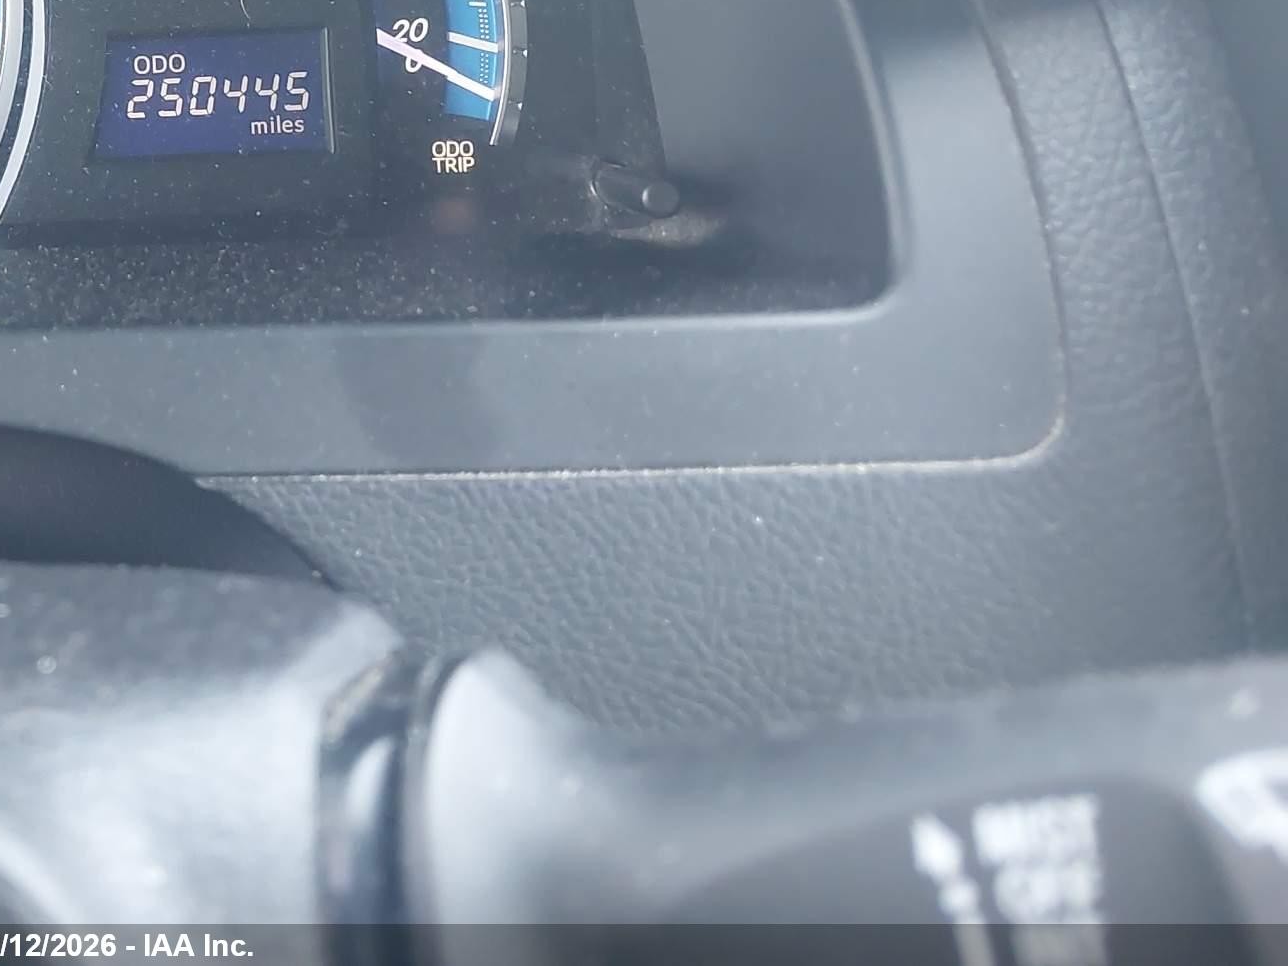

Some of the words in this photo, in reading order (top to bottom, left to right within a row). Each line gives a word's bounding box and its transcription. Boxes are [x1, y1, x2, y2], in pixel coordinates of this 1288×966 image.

[390, 18, 430, 44] 20
[134, 53, 186, 75] ODO
[126, 70, 311, 120] 250445
[251, 114, 305, 135] miles
[432, 140, 474, 158] ODO
[432, 156, 475, 174] TRIP
